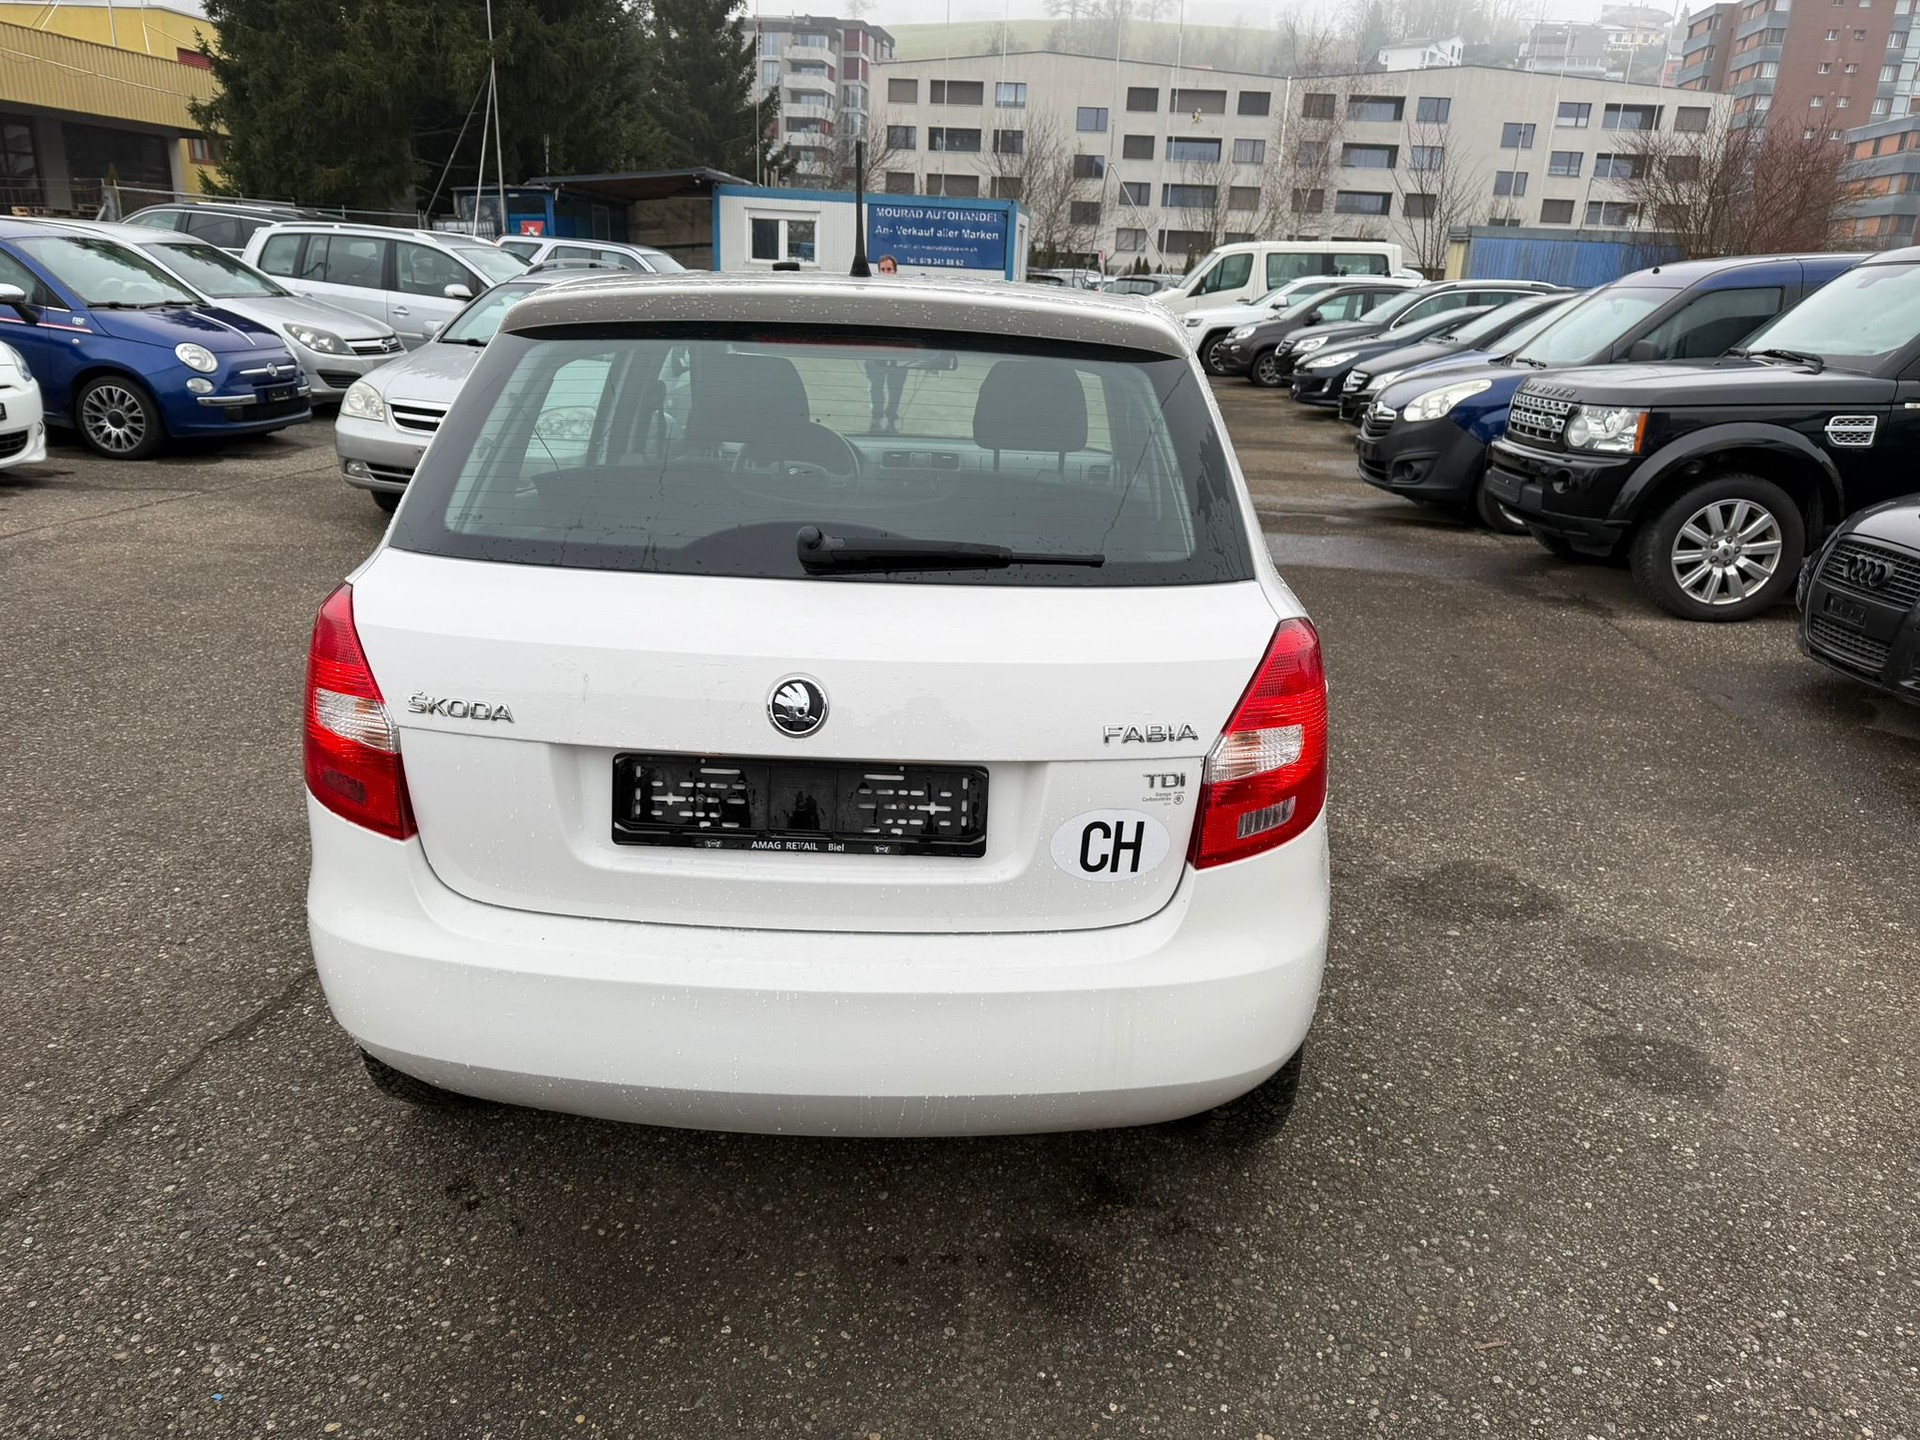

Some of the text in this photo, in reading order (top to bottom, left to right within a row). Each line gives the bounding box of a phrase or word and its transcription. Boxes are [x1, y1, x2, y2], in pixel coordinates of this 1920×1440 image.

[876, 207, 997, 222] MOURAD AUTOHANDEL
[875, 225, 999, 240] An- Verkauf aller Marken
[407, 690, 515, 724] ŠKODA
[1103, 723, 1199, 745] FABIA
[1142, 772, 1187, 789] TDI
[751, 840, 845, 852] AMAG RETAIL Biel
[1079, 820, 1145, 873] CH
